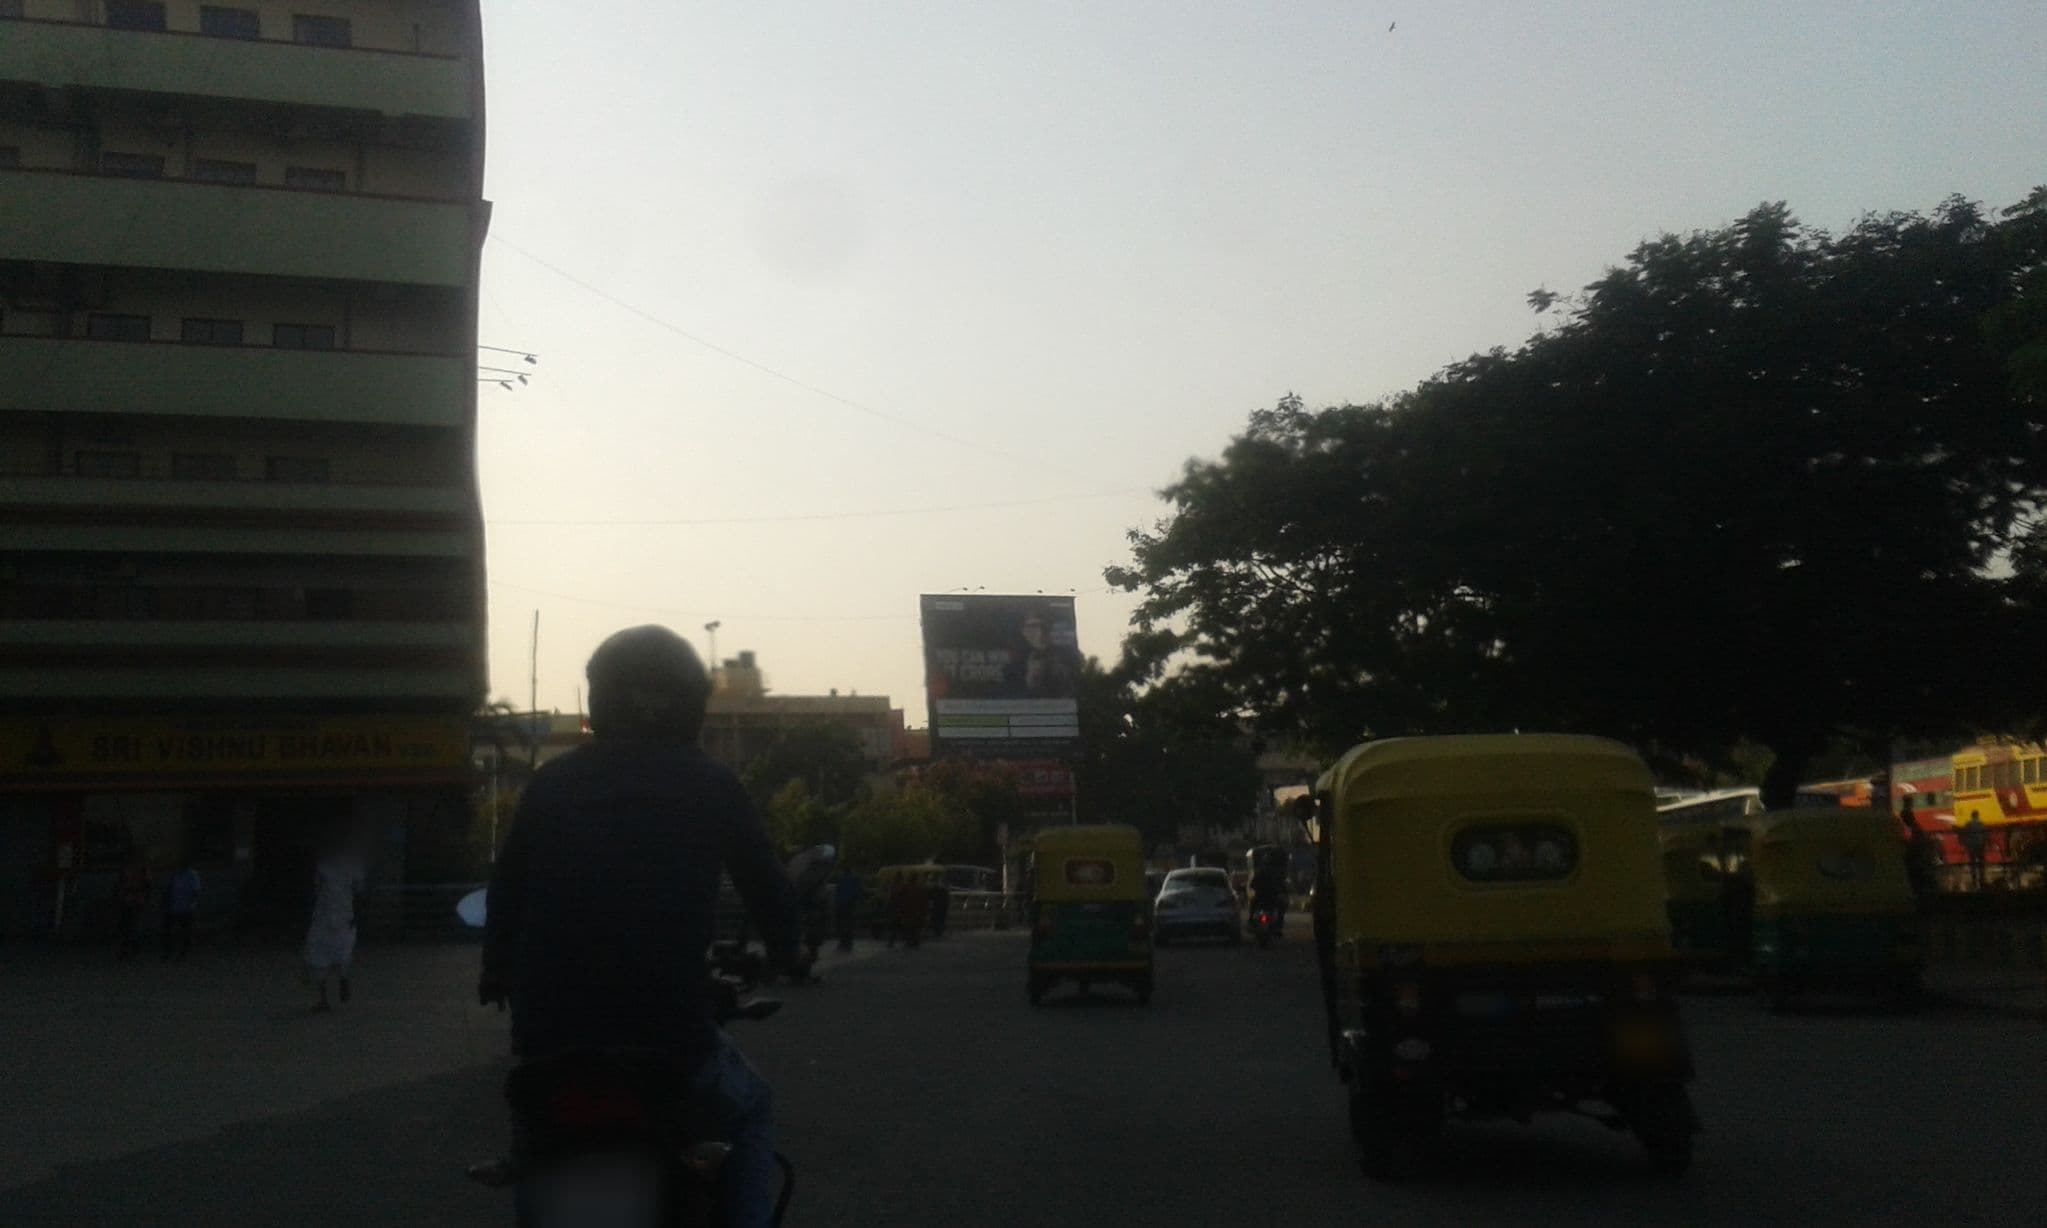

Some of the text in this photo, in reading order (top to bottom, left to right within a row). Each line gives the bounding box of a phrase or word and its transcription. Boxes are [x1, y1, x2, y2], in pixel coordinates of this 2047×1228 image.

[91, 736, 141, 761] SRI
[156, 735, 267, 761] VISHNU
[279, 735, 393, 760] BHAVAN
